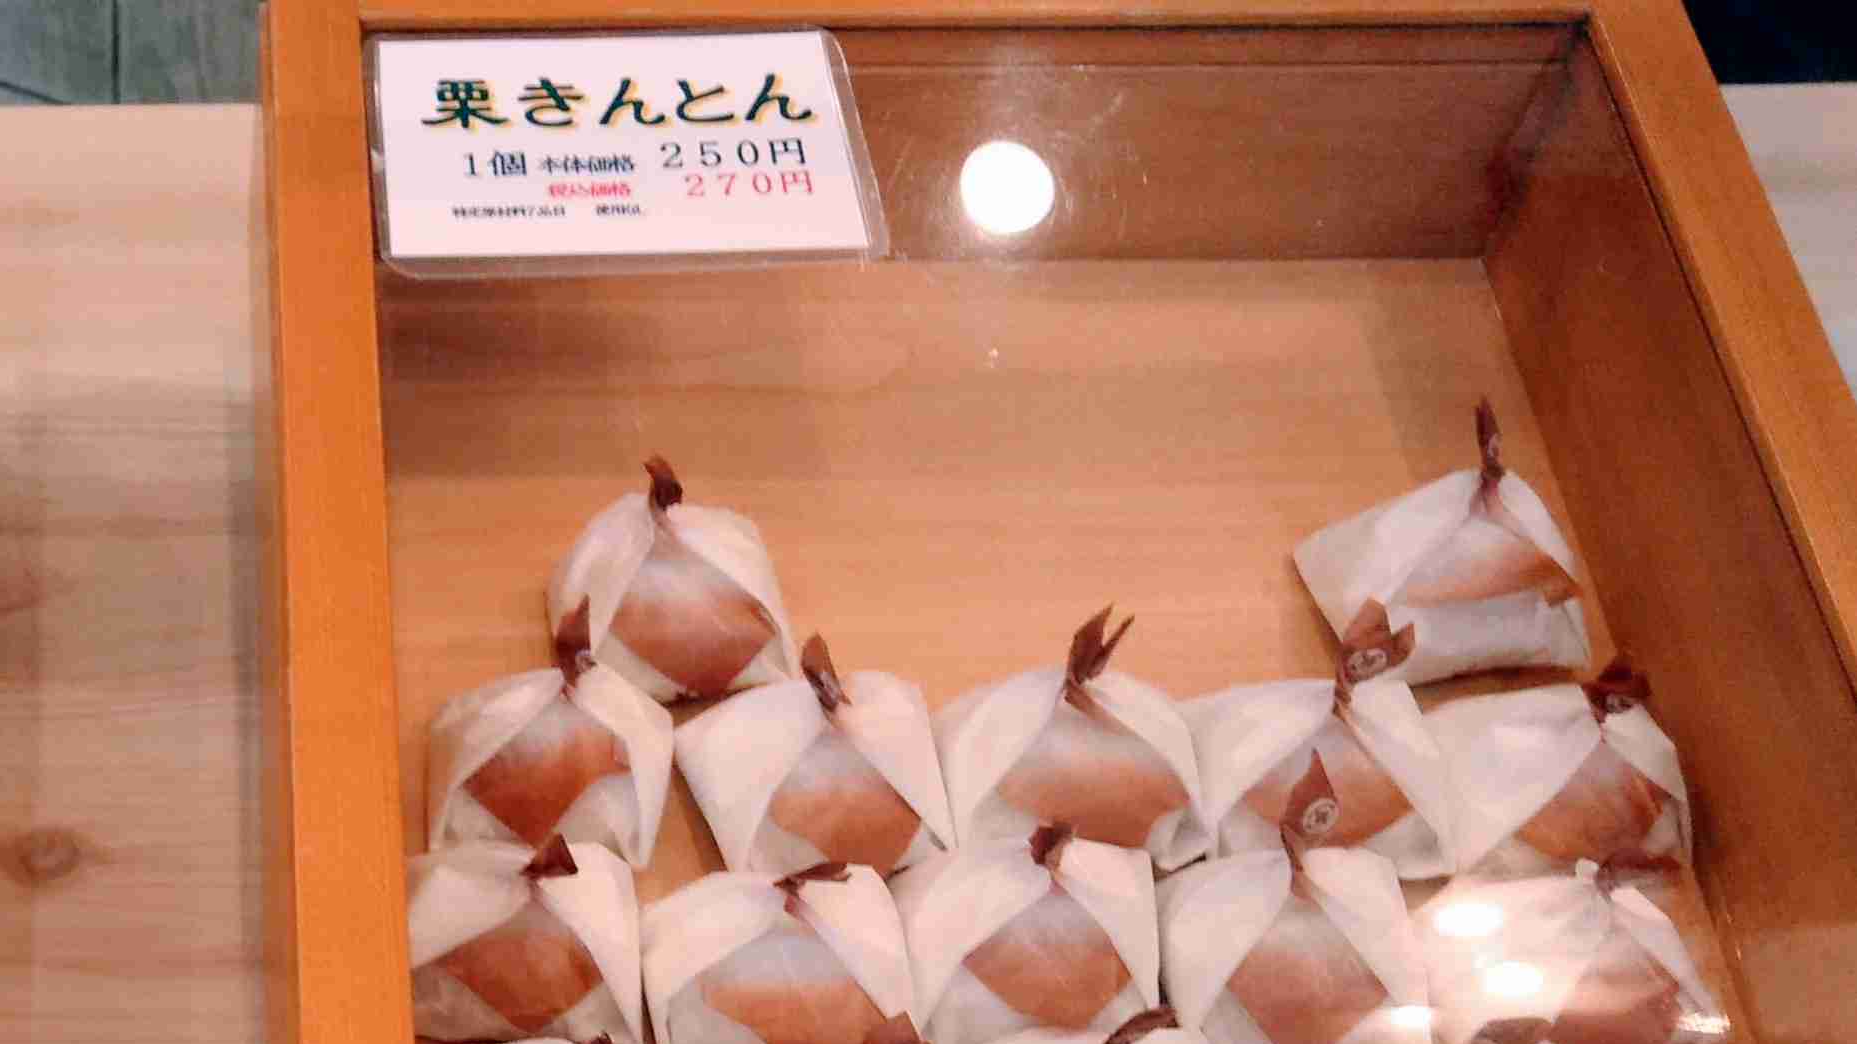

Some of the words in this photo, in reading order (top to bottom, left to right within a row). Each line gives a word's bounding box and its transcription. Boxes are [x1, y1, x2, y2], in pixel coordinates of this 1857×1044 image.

[421, 73, 816, 130] 栗きんとん
[468, 150, 528, 177] 1個
[660, 138, 806, 168] 250円
[684, 169, 813, 197] 270円
